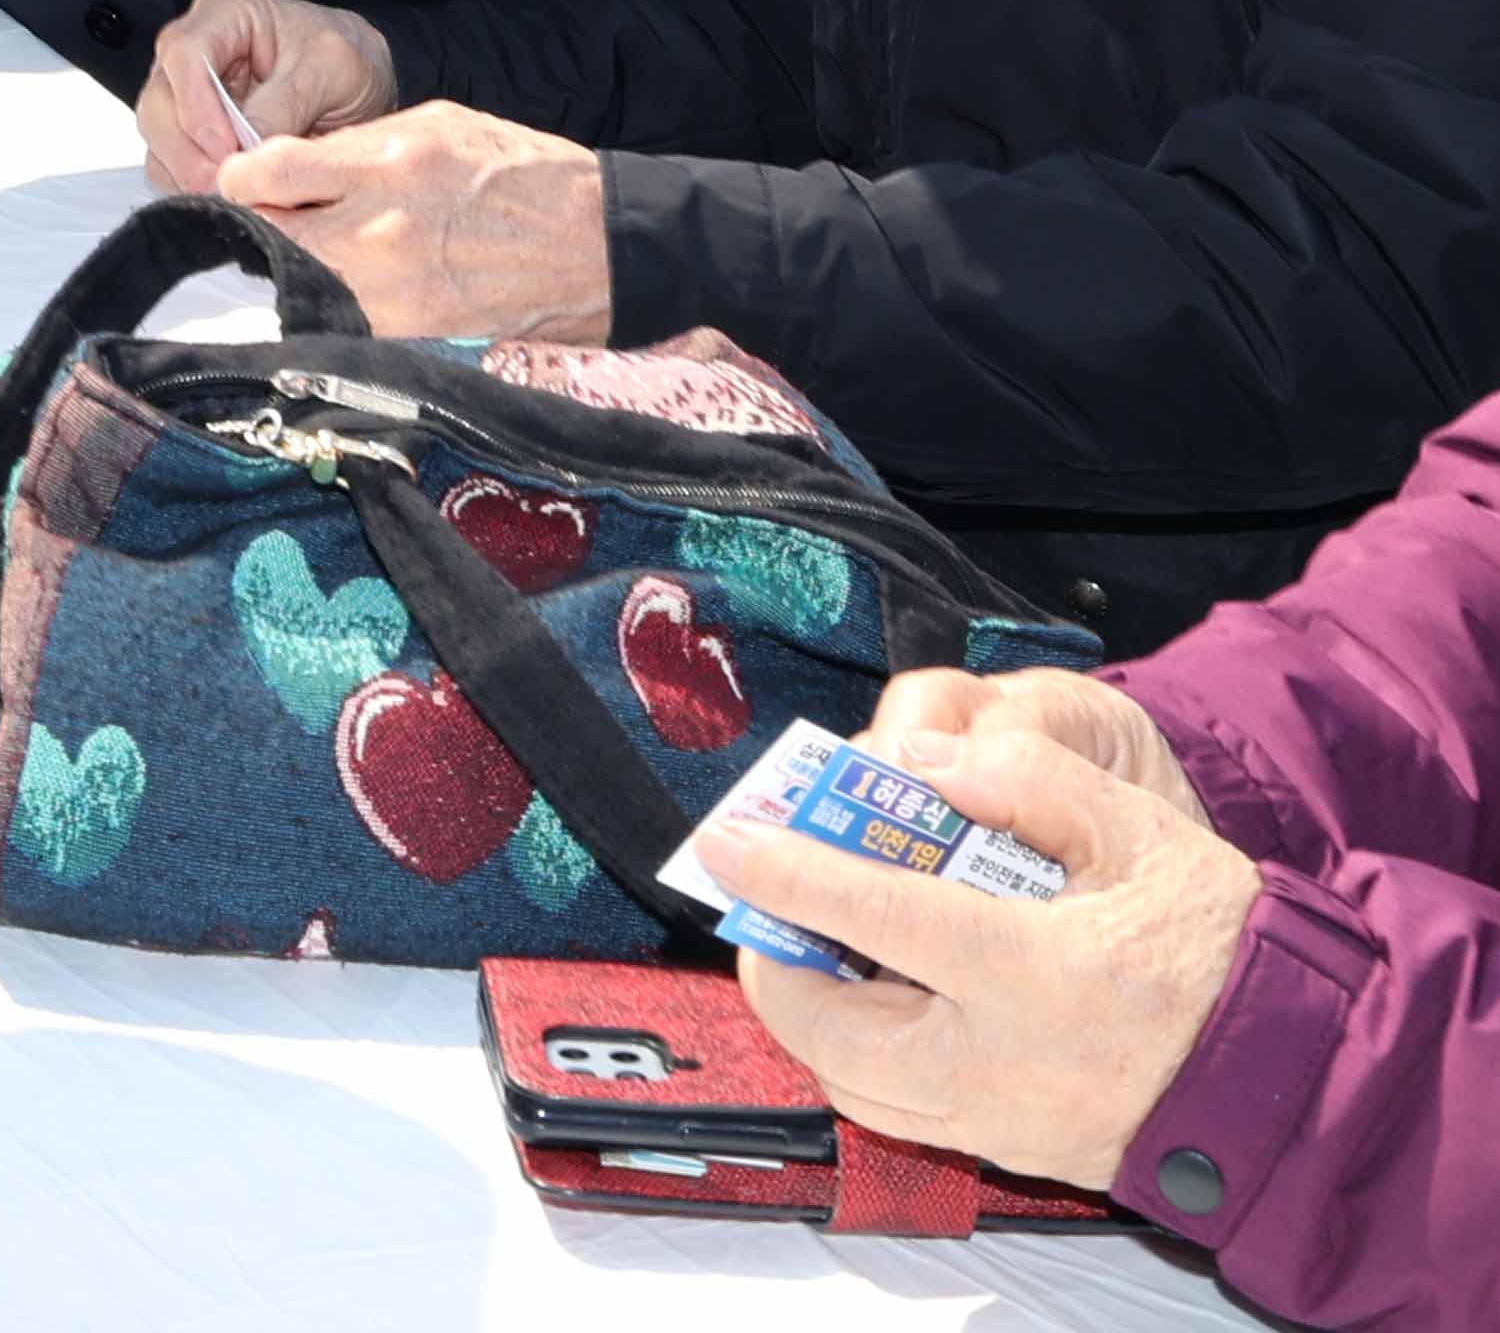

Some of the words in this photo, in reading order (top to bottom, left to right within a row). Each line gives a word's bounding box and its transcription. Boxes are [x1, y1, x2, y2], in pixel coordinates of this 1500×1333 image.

[852, 770, 877, 800] 1
[873, 777, 951, 832] 허종식
[860, 819, 913, 860] 인천
